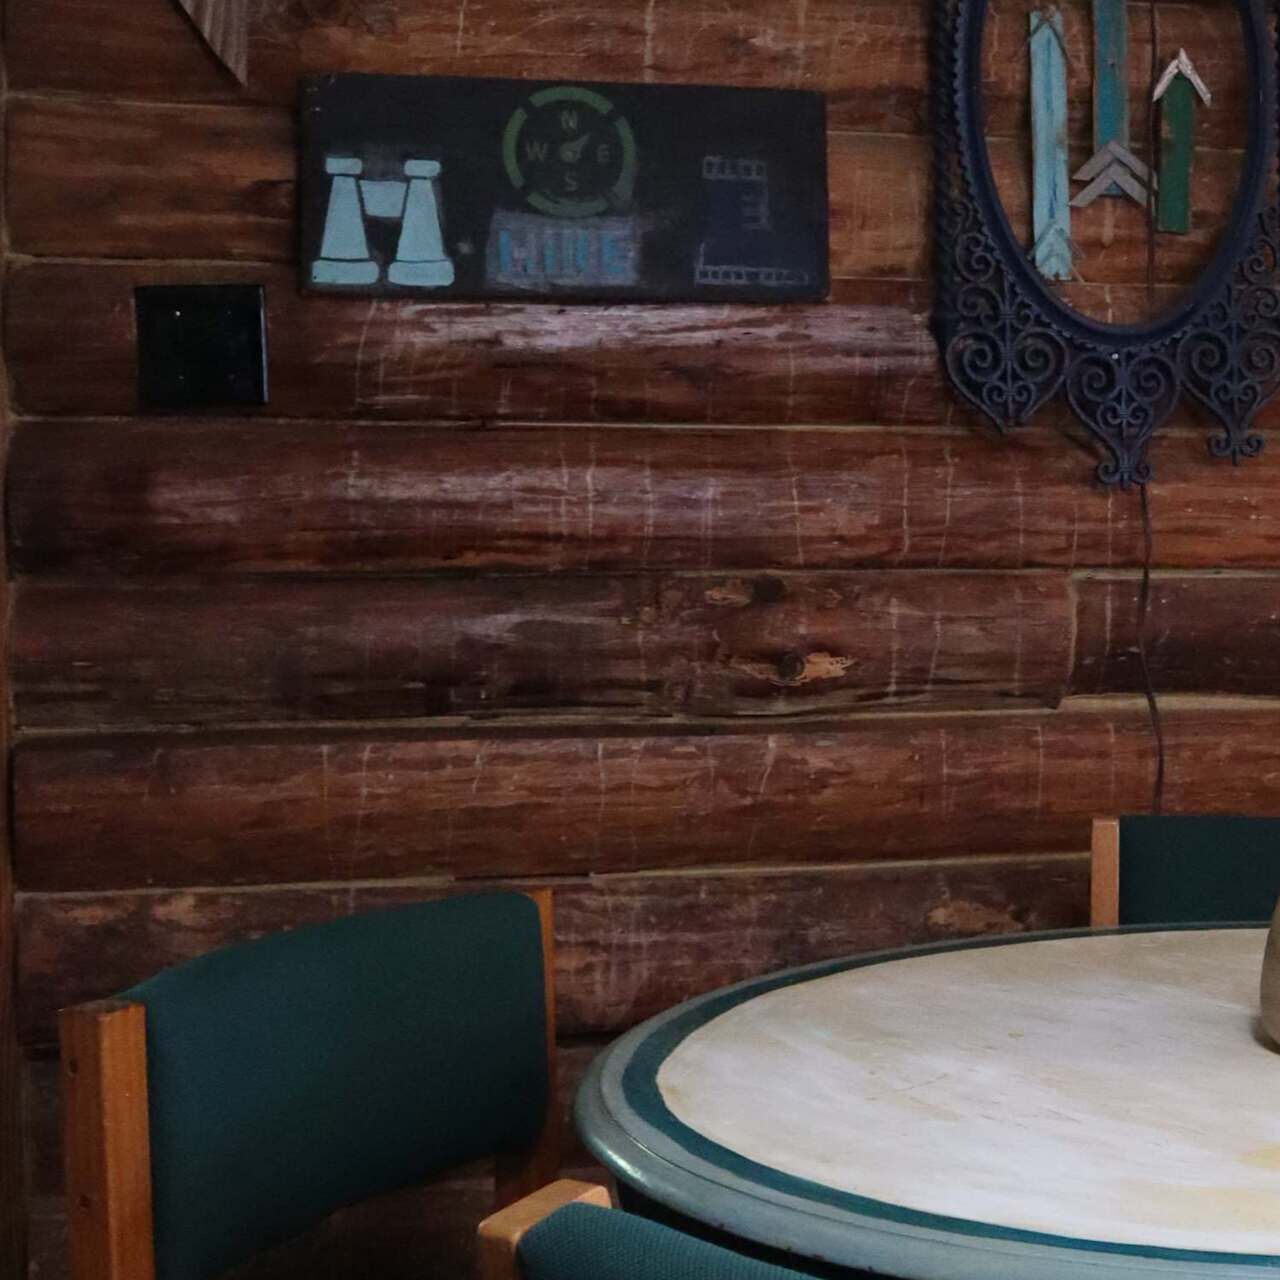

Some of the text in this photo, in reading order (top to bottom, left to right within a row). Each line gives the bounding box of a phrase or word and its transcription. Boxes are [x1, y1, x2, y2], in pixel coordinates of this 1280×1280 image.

[561, 109, 579, 130] N
[525, 141, 549, 161] W
[596, 144, 611, 162] E
[564, 170, 578, 192] S
